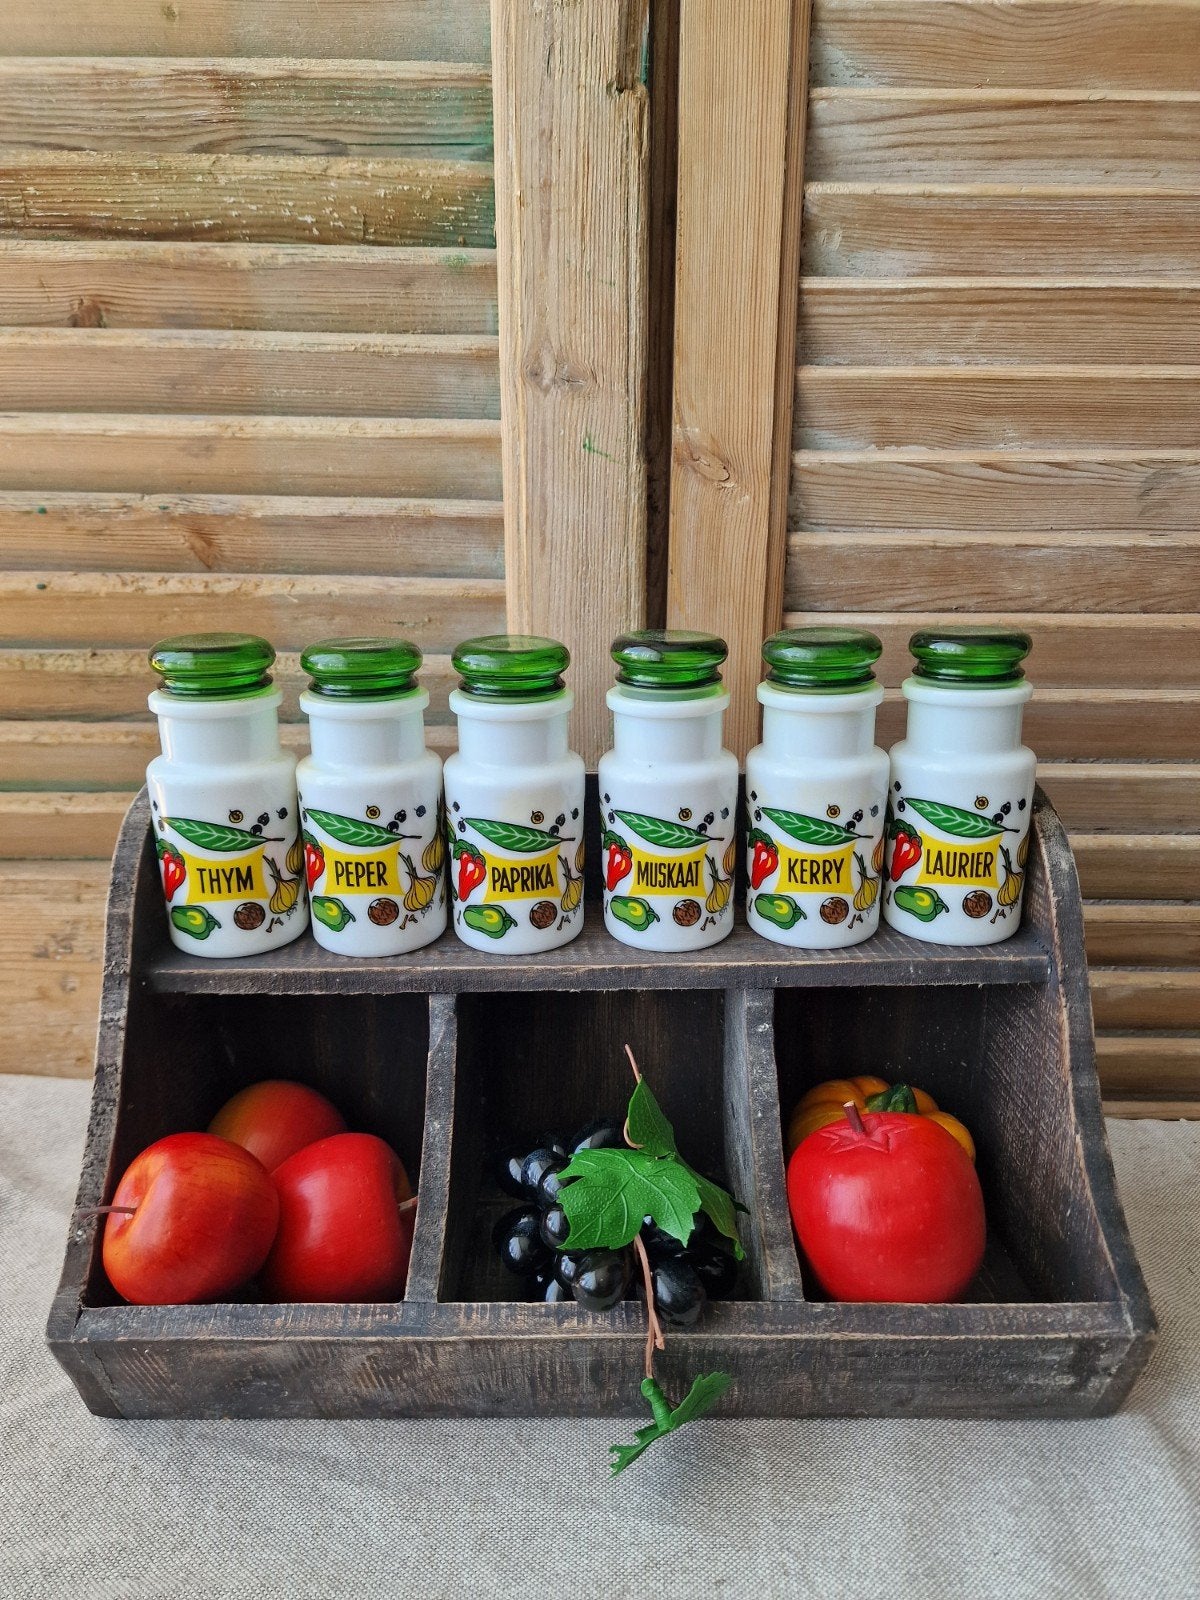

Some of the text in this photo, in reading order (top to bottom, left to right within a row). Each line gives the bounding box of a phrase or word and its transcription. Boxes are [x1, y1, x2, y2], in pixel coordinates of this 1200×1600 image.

[334, 860, 389, 888] PEPER
[637, 860, 701, 889] MUSKAAT
[788, 858, 845, 885] KERRY
[925, 849, 993, 878] LAURIER
[196, 866, 254, 894] THYM
[491, 863, 555, 893] PAPRIKA
